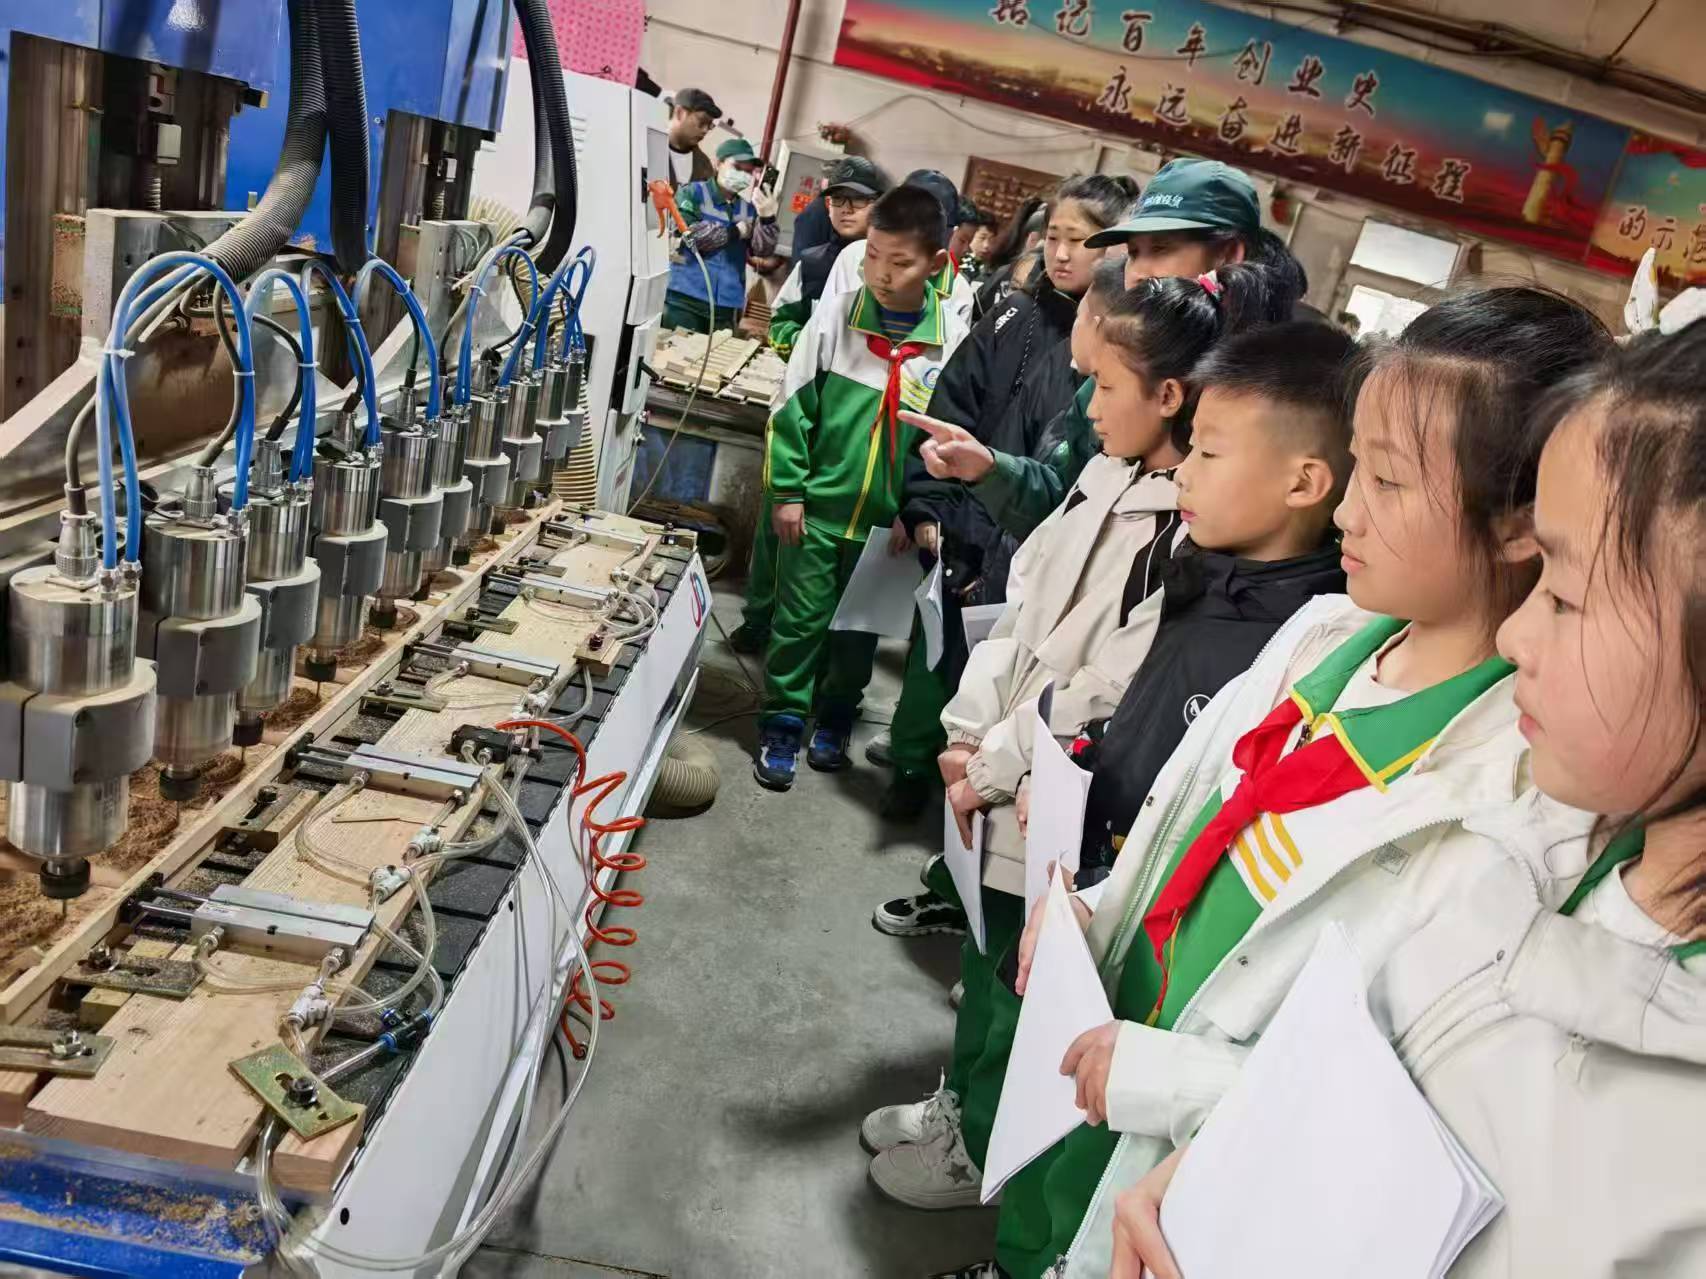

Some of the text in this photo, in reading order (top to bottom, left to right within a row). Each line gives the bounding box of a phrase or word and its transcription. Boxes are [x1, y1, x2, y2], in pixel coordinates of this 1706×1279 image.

[1098, 65, 1470, 202] 永远奋进新征程
